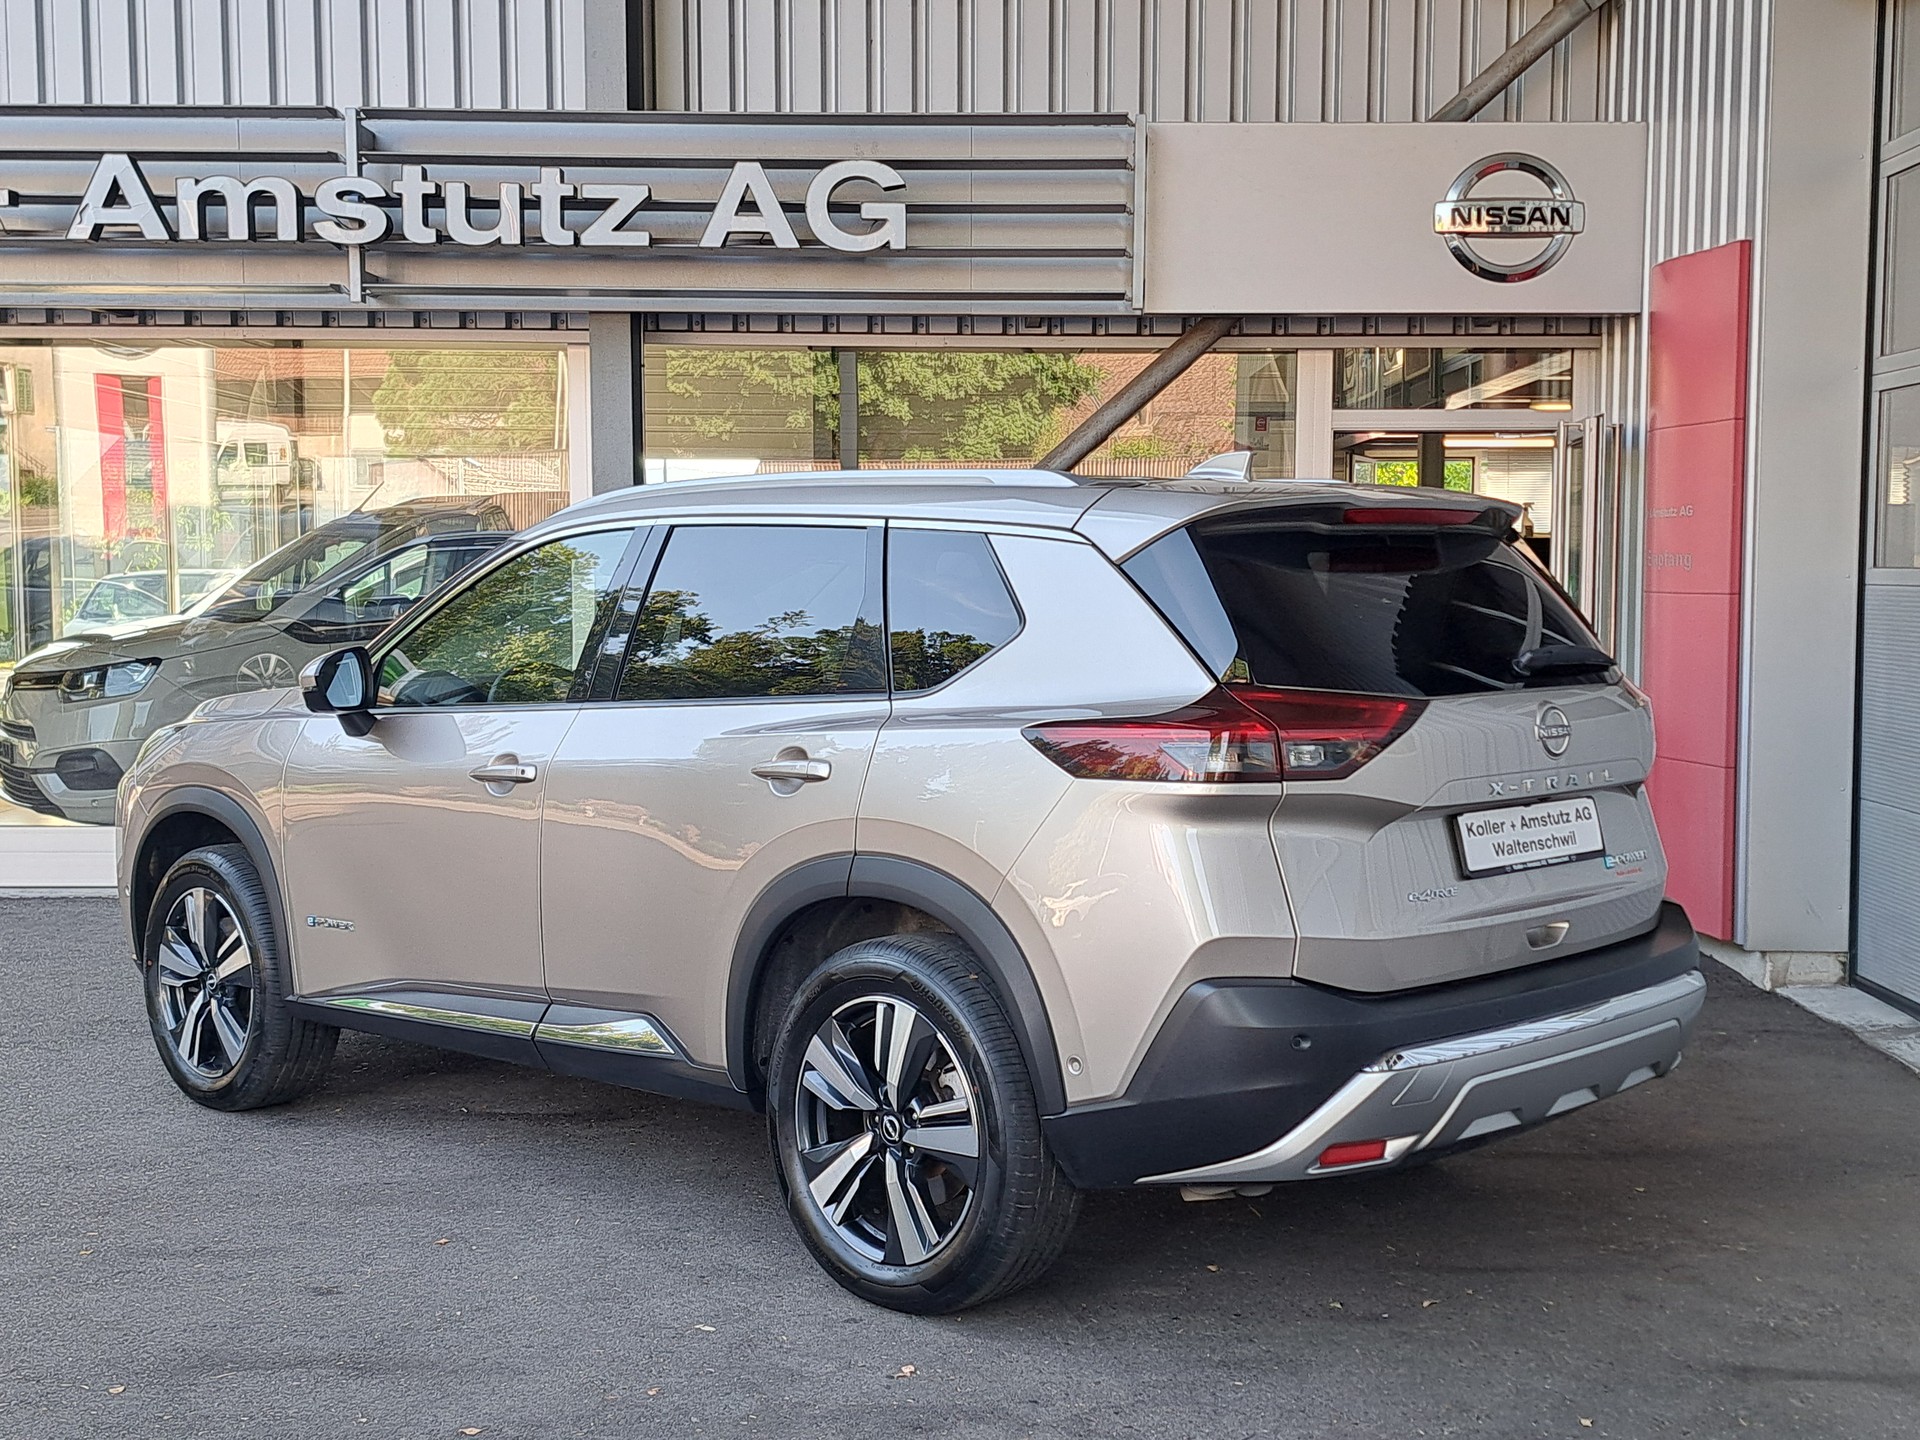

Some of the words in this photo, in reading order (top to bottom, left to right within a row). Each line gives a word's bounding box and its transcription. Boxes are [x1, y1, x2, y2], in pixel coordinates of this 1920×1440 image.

[66, 152, 651, 247] Amstutz
[699, 160, 907, 252] AG
[1449, 206, 1571, 226] NISSAN
[1680, 505, 1694, 517] AG
[1489, 769, 1614, 797] X-TRAIL
[1465, 819, 1506, 838] Koller
[1507, 820, 1517, 832] +
[1520, 809, 1572, 830] Amstutz
[1575, 806, 1593, 823] AG
[1492, 831, 1577, 857] Waltenschwil
